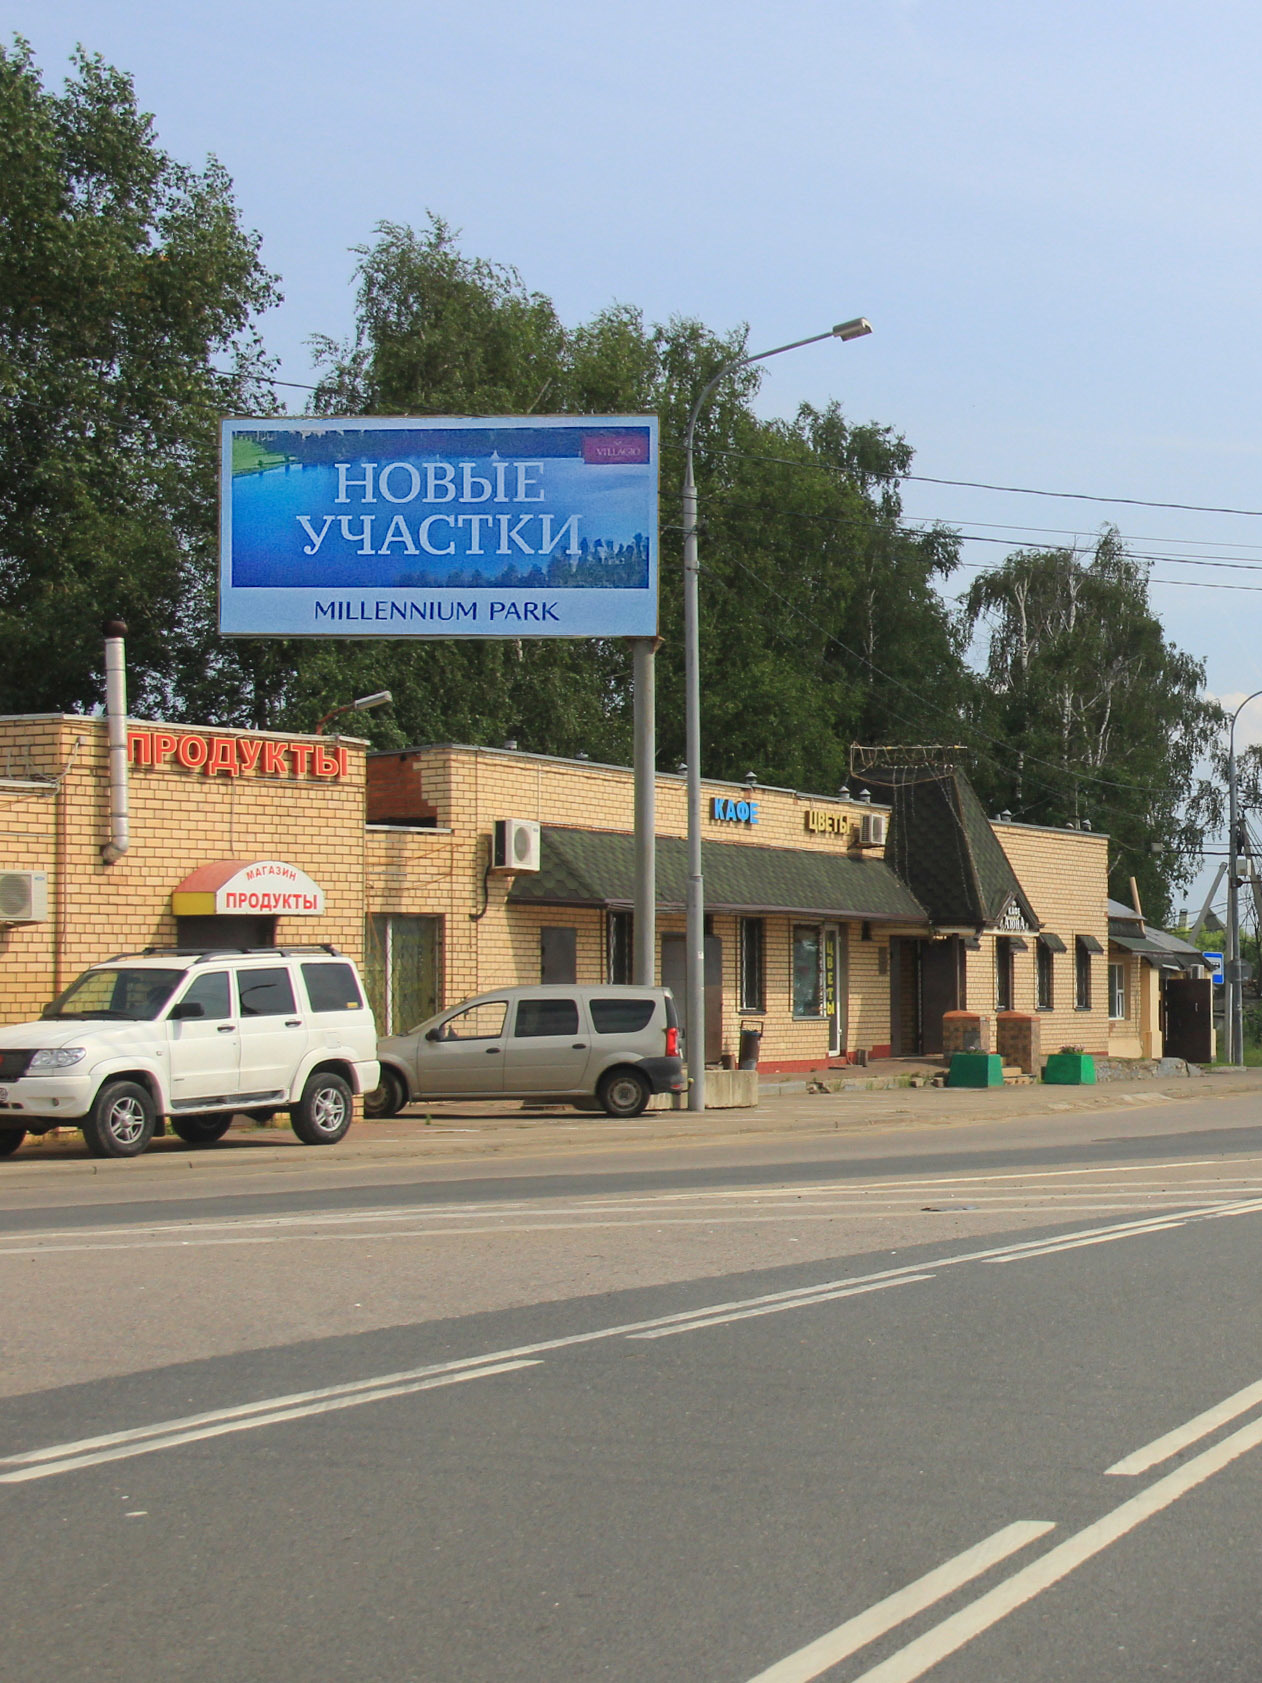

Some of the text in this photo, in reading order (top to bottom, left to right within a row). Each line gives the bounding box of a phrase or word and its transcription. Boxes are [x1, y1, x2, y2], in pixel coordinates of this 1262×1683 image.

[334, 461, 546, 504] НОВЫЕ
[296, 513, 583, 556] УЧАСТКИ
[314, 600, 560, 621] MILLENNIUM PARK
[127, 731, 350, 778] ПРОДУКТЫ
[711, 797, 760, 824] КАФЕ
[807, 810, 851, 835] ЦВЕТЫ
[246, 866, 298, 881] МАГАЗИН
[225, 892, 318, 912] ПРОДУКТЫ
[1008, 907, 1021, 915] КАФЕ
[826, 940, 835, 1015] ЦВЕТЫ
